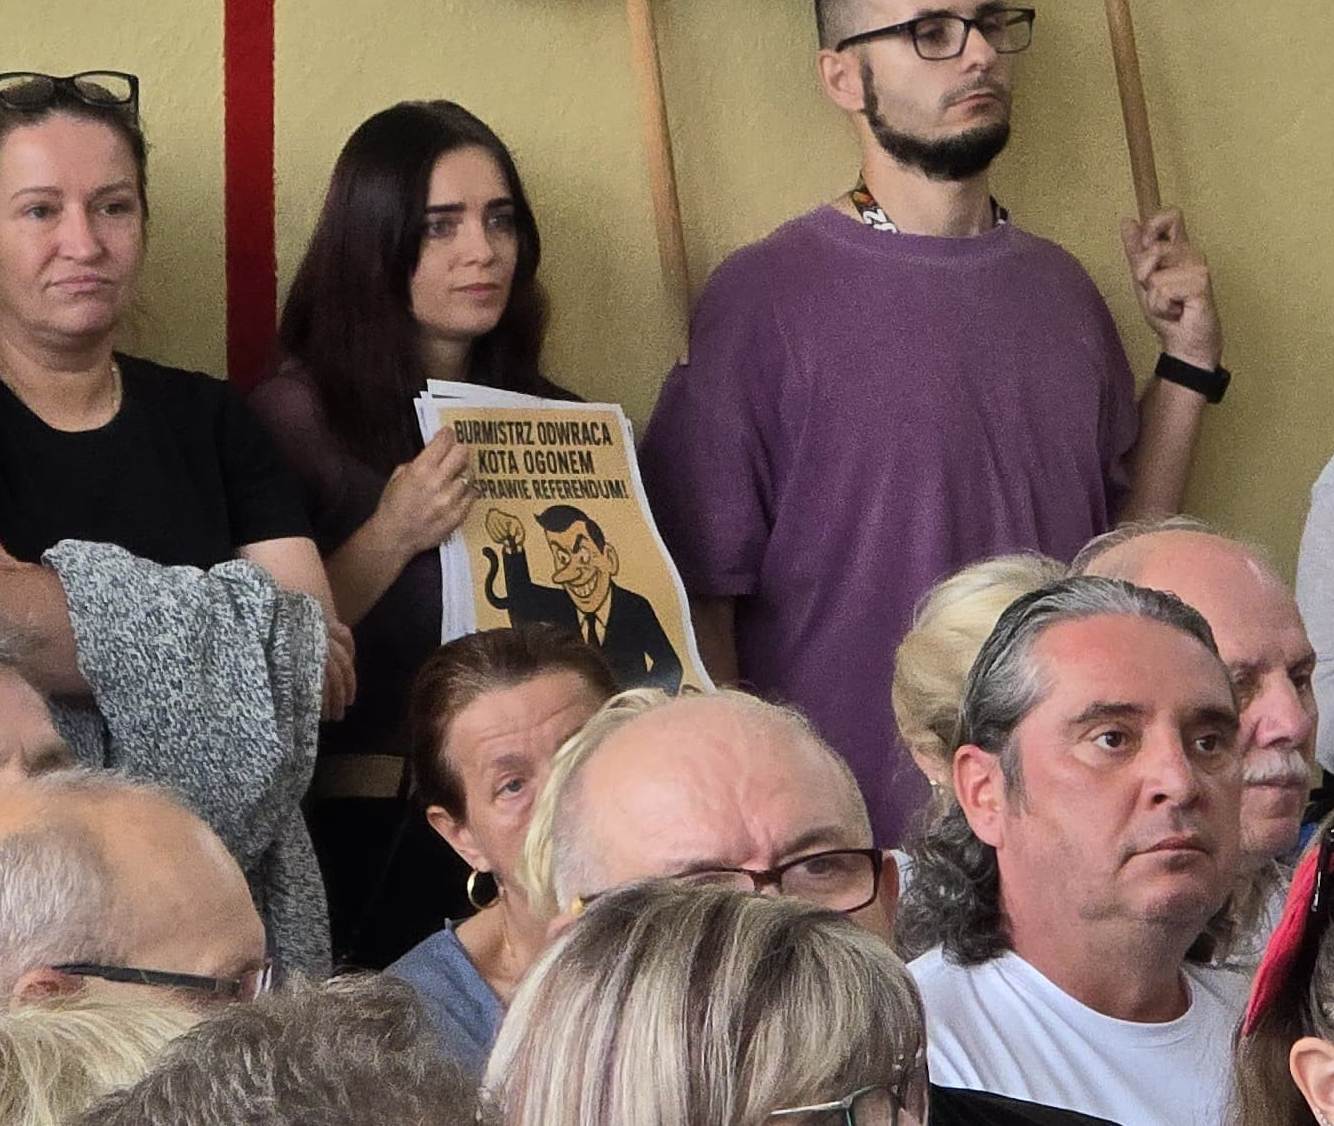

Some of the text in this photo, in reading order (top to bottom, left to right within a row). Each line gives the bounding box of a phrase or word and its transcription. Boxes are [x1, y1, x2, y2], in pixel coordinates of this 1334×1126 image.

[453, 420, 613, 446] BURMISTRZ ODWRACA
[478, 449, 595, 474] KOTA OGONEM
[532, 479, 630, 500] REFERENDUM!
